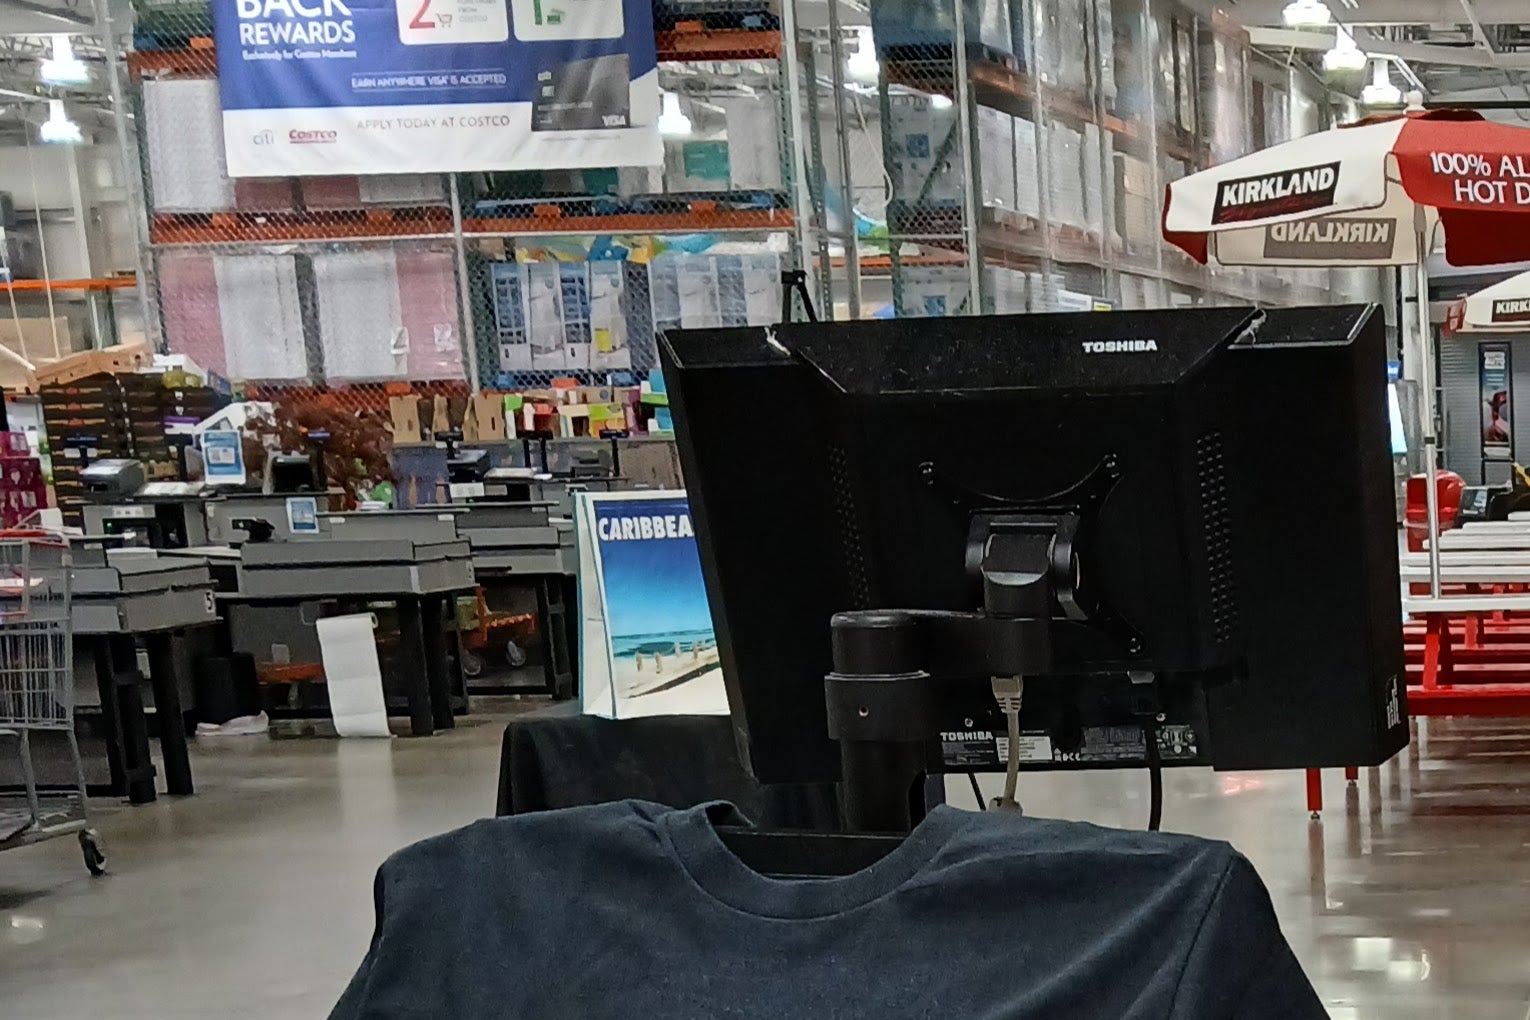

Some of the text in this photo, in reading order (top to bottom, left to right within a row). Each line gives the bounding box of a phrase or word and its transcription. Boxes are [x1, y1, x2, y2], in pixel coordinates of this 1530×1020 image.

[239, 20, 356, 46] REWARDS
[356, 115, 511, 129] APPLY TODAY AT COSTCO
[601, 114, 626, 127] VISA
[253, 129, 275, 145] citi
[288, 129, 338, 140] COSTCO
[1430, 151, 1492, 176] 100%
[1221, 167, 1335, 207] KIRKLAND
[1454, 179, 1507, 203] HOT
[1082, 339, 1158, 353] TOSHIBA
[598, 515, 695, 541] CARIBBEA
[940, 731, 994, 741] TOSHIBA
